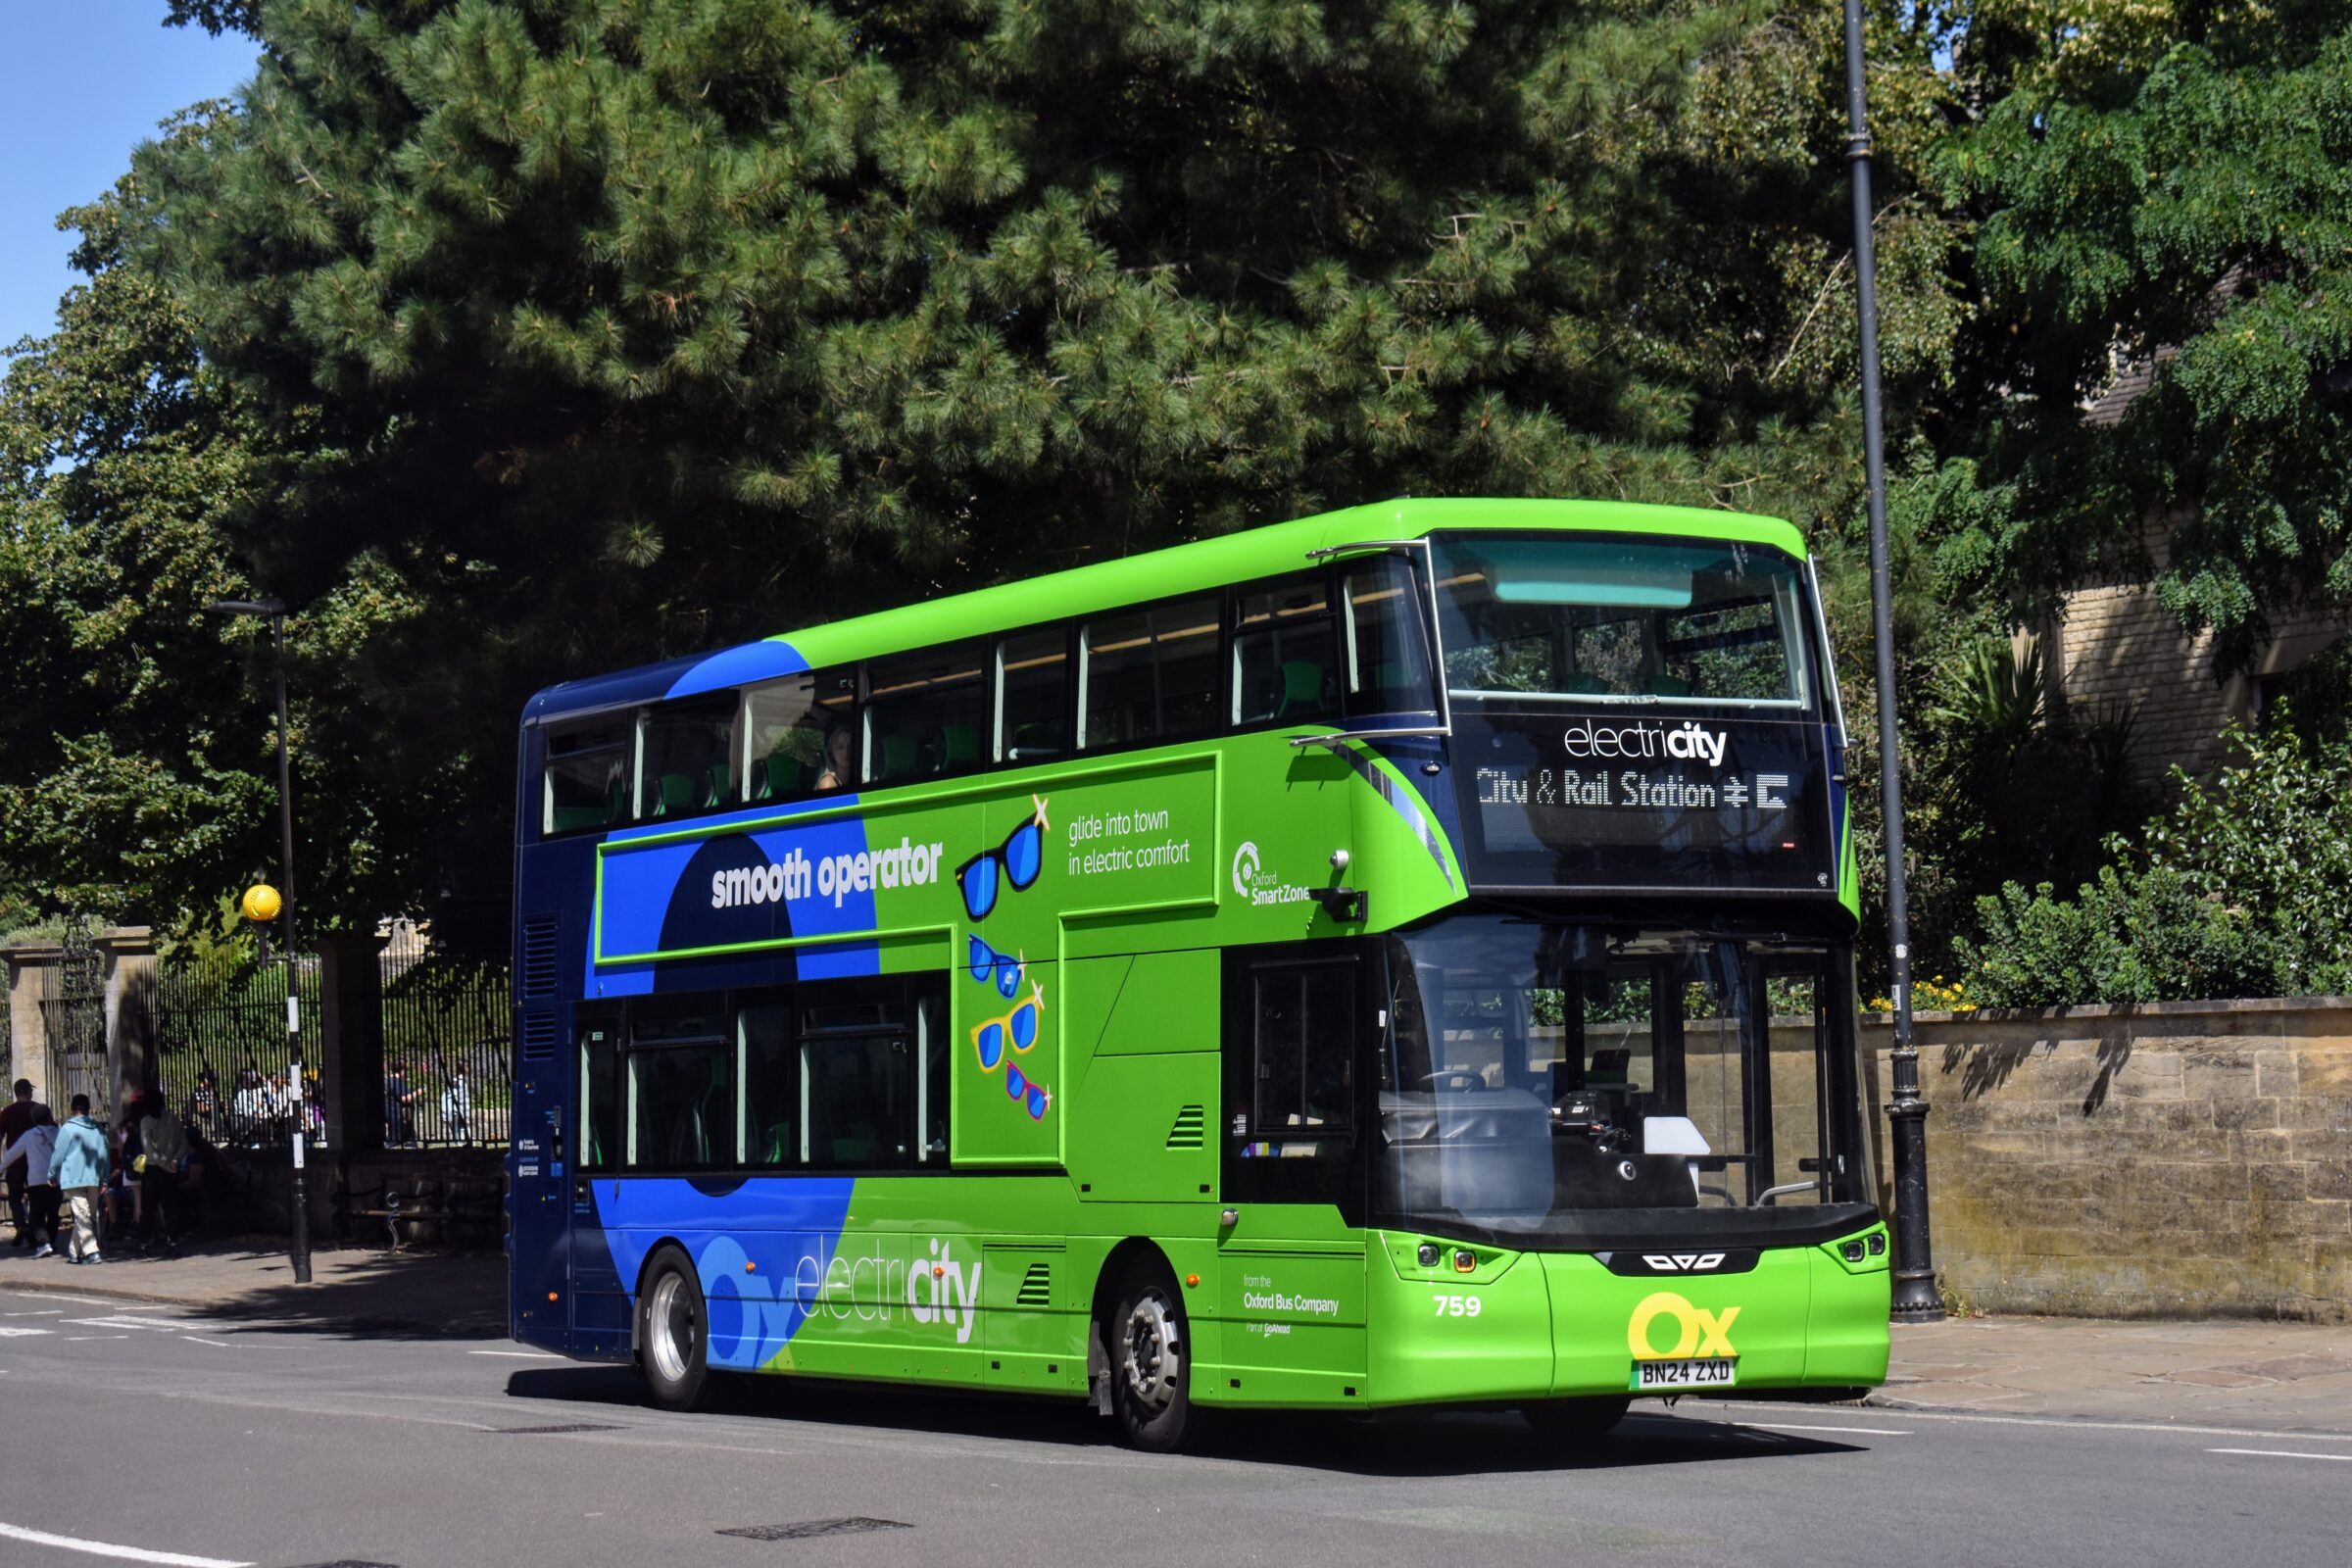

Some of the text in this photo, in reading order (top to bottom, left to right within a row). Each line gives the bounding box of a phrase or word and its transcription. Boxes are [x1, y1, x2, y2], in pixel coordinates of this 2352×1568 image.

[1564, 718, 1727, 766] electricity
[1477, 768, 1716, 808] City & Rail Station
[1069, 808, 1169, 846] glide into town
[1068, 839, 1190, 875] in electric comfort
[711, 836, 944, 909] smooth operator
[1251, 870, 1277, 887] Oxford
[1251, 884, 1310, 906] SmartZone
[795, 1234, 982, 1344] electricity
[1244, 1274, 1271, 1288] from the
[1244, 1292, 1339, 1316] Oxford Bus Company
[1433, 1295, 1482, 1317] 759
[1247, 1322, 1257, 1332] Part
[1628, 1292, 1741, 1360] Ox
[1642, 1360, 1730, 1384] BN24 ZXD
